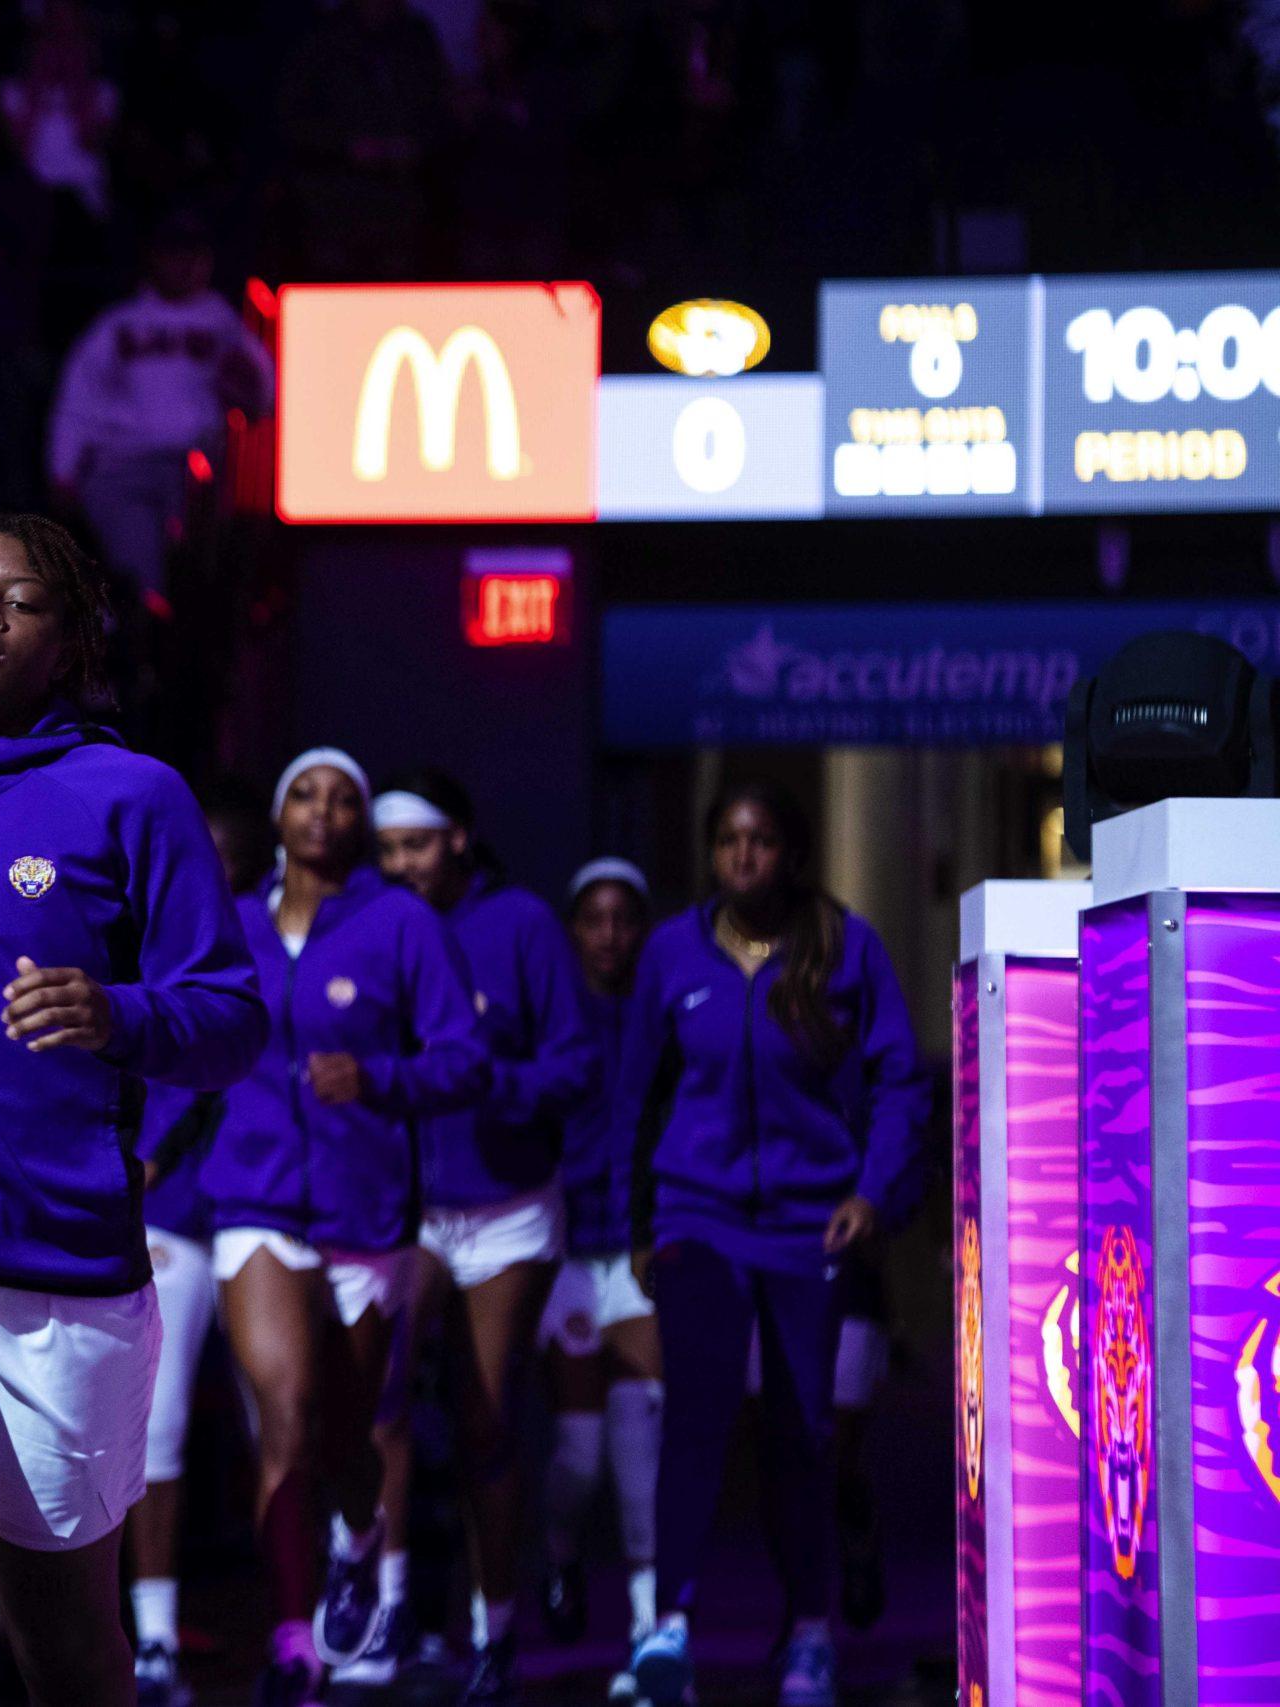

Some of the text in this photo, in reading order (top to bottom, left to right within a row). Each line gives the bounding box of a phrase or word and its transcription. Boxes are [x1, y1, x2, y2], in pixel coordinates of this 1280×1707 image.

[910, 334, 962, 398] 0
[674, 396, 746, 494] 0
[1075, 429, 1246, 482] PERIOD
[483, 577, 554, 639] EXIT
[787, 645, 1079, 713] accutemp
